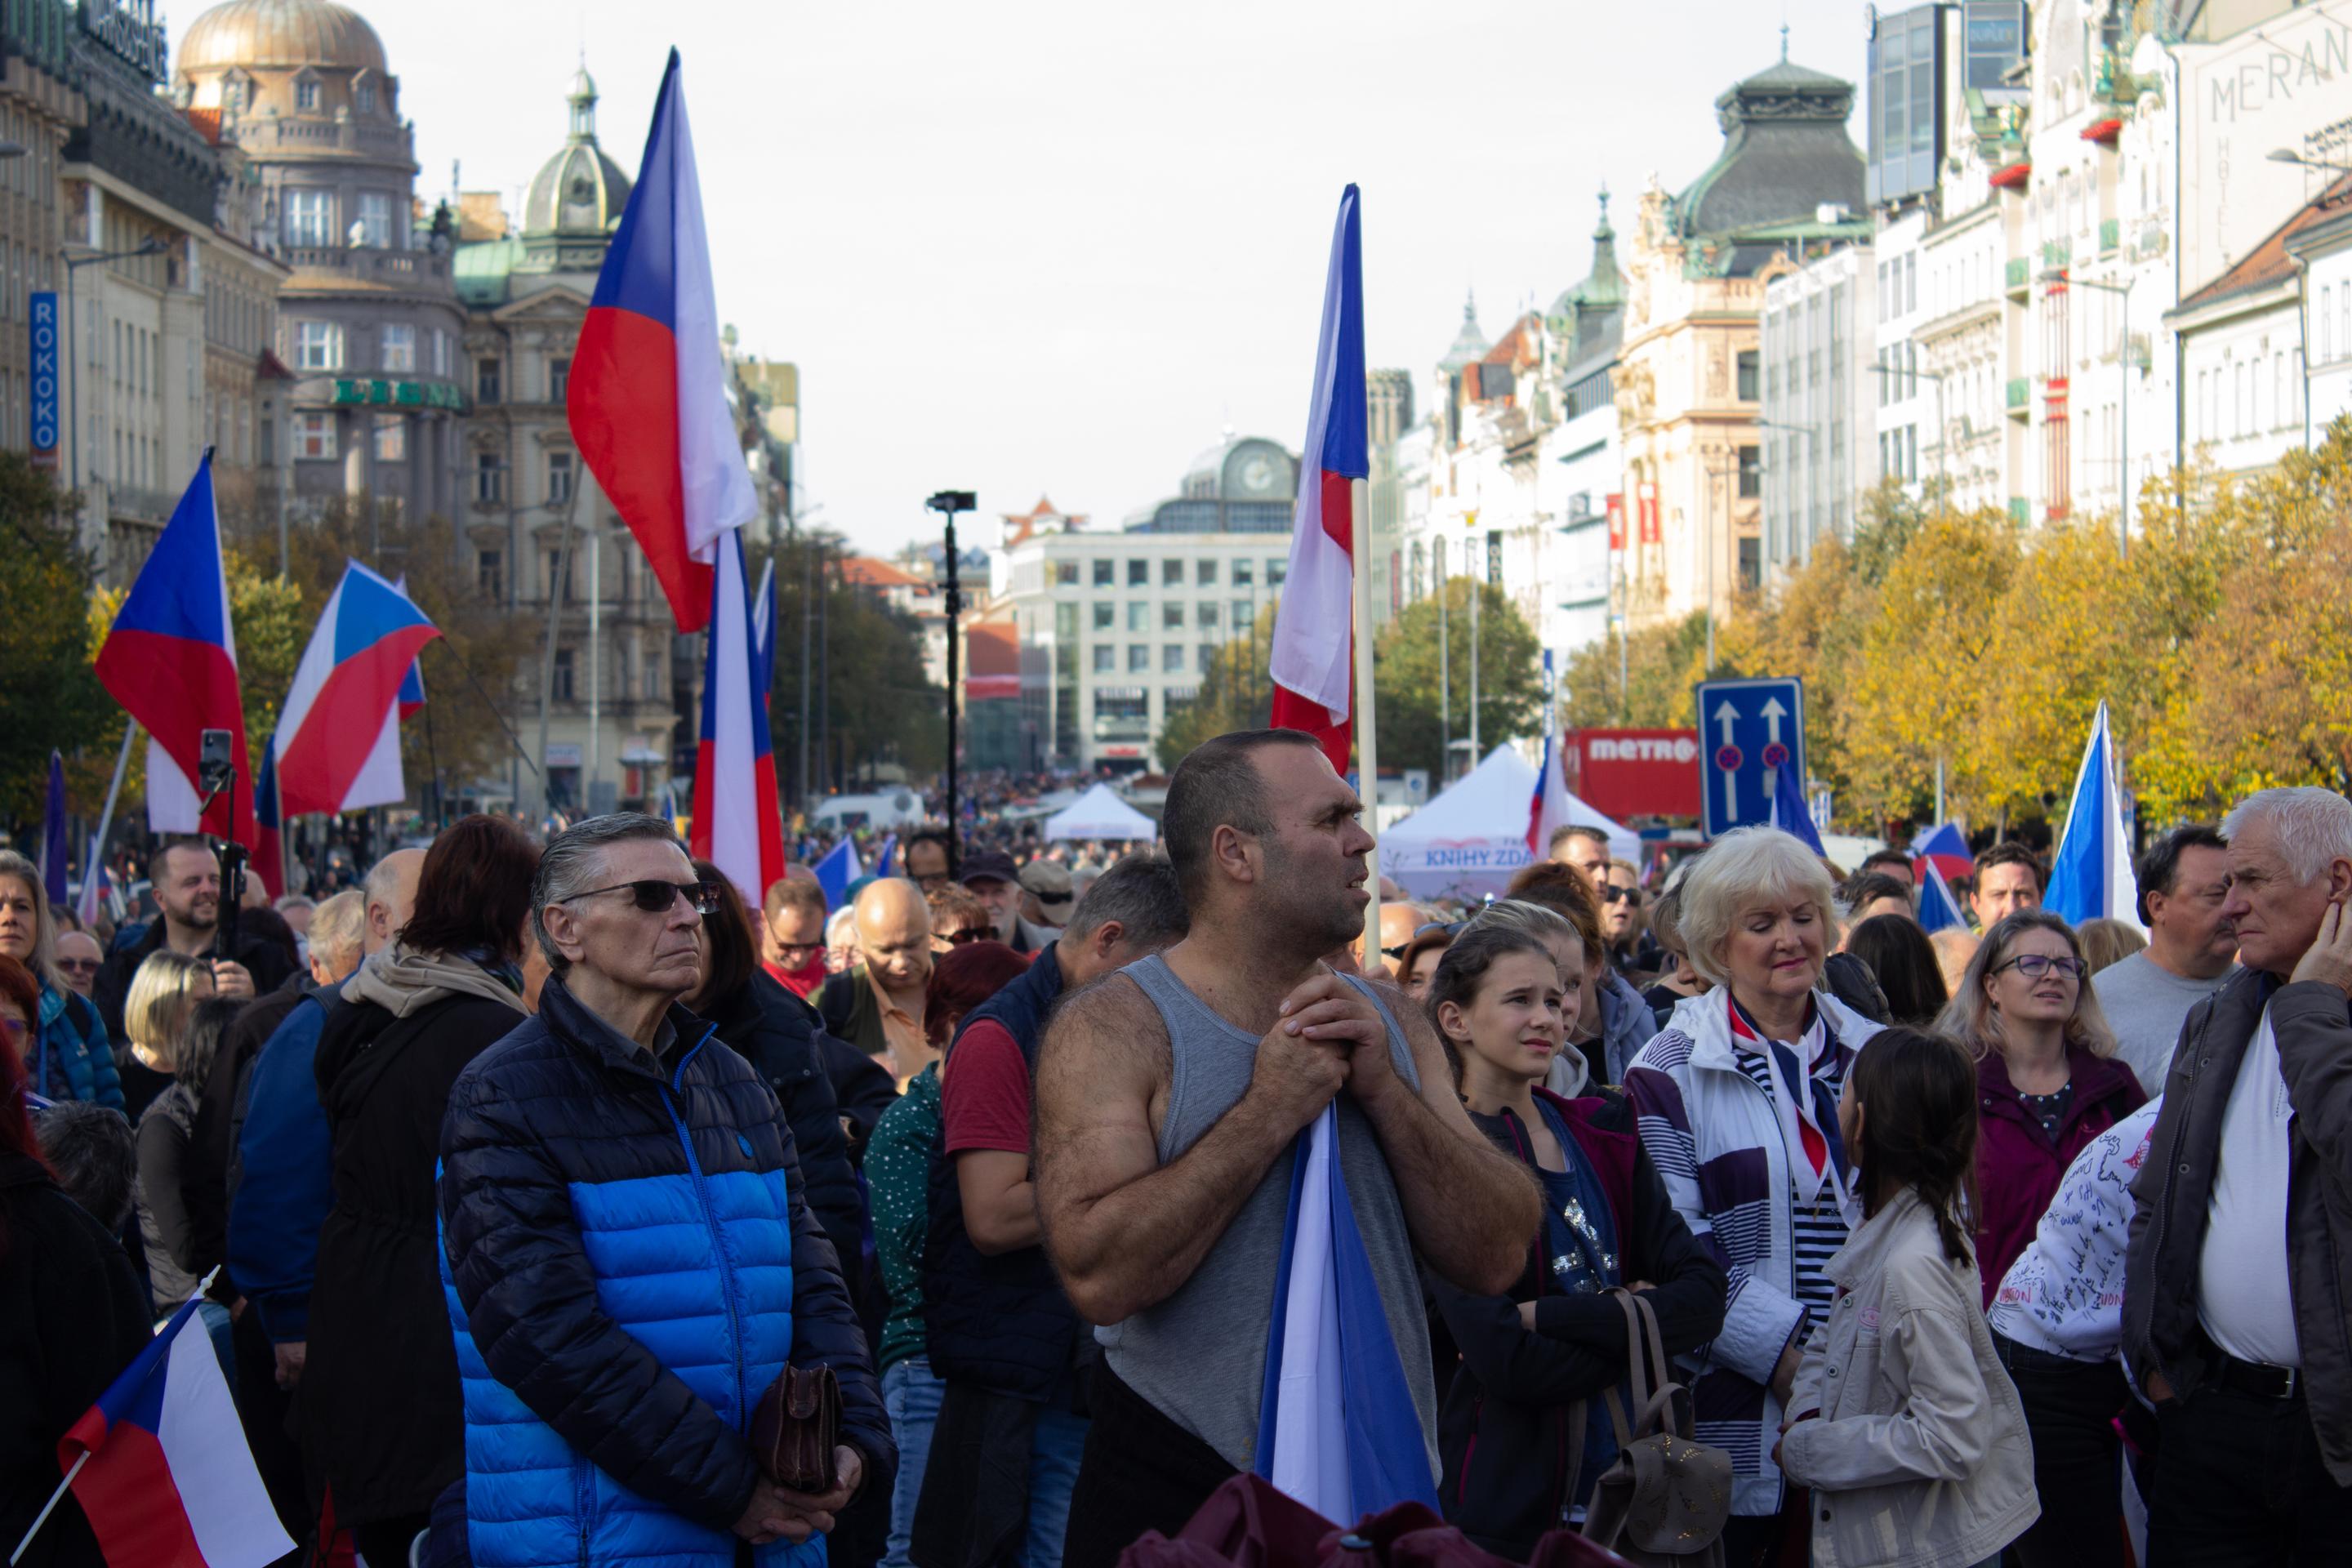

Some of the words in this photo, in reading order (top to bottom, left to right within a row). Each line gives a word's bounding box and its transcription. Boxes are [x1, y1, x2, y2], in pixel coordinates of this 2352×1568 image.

[2211, 26, 2350, 122] MERAN
[2216, 136, 2231, 249] HOTEL
[35, 302, 54, 448] ROKOKO
[1427, 849, 1491, 866] KNIHY
[1495, 849, 1534, 866] ZDA
